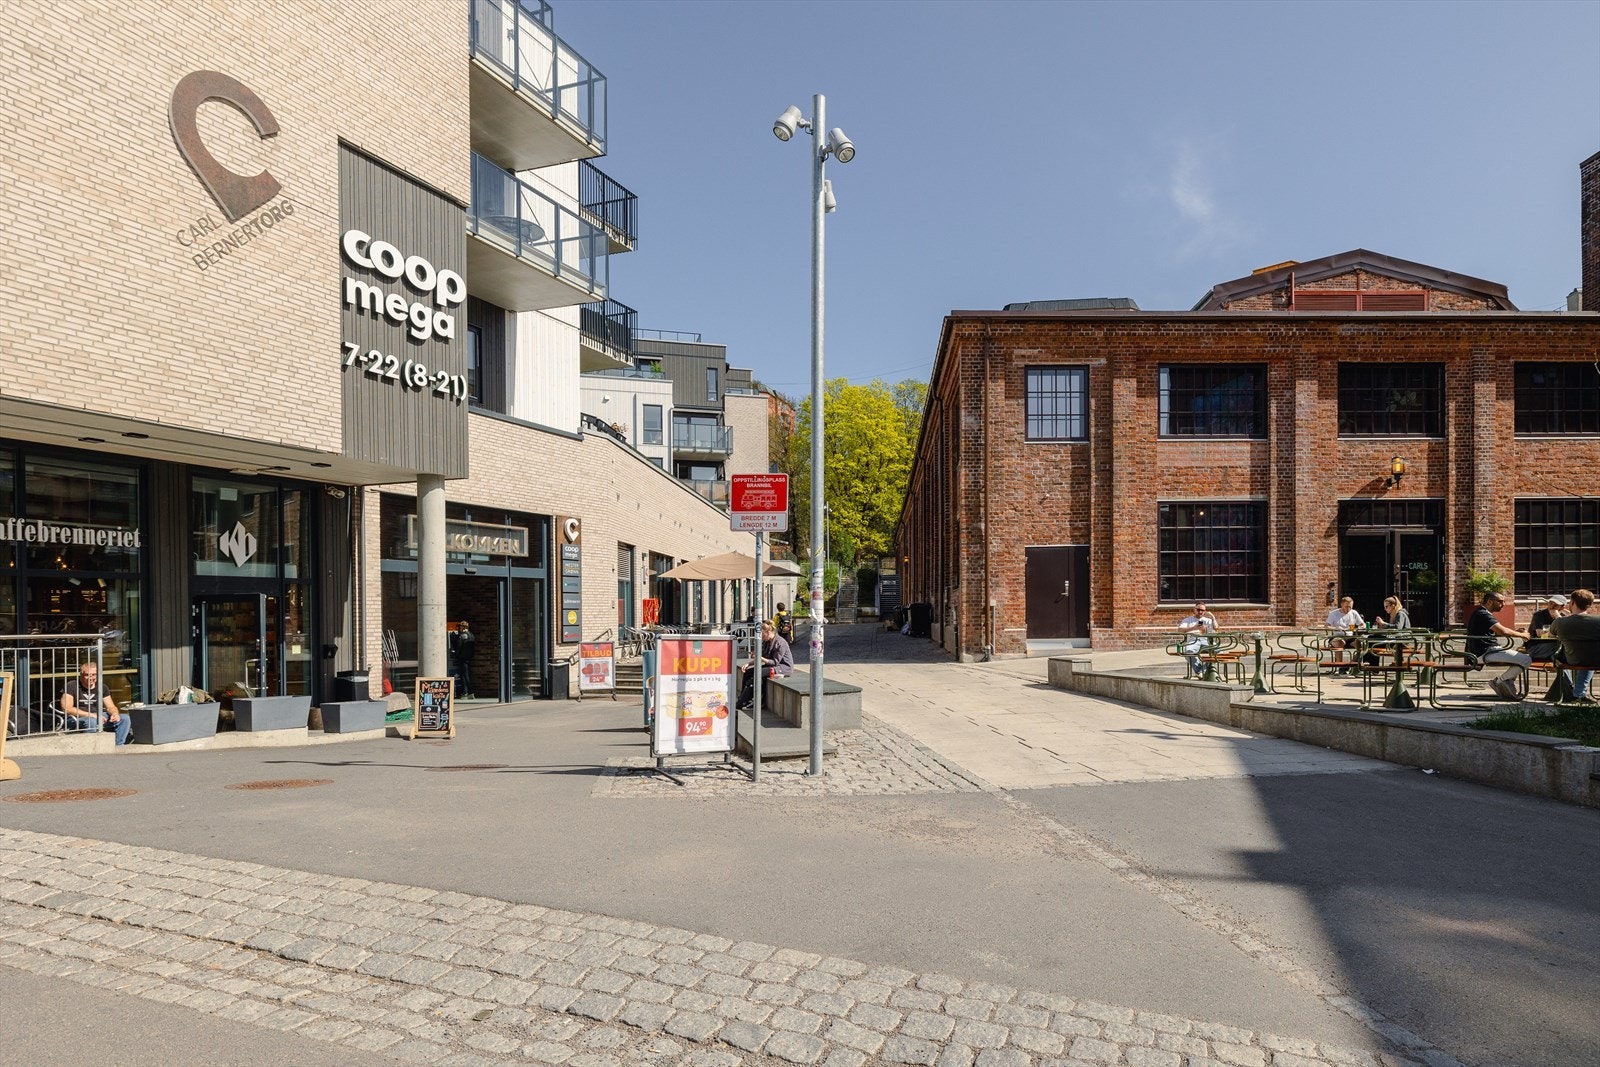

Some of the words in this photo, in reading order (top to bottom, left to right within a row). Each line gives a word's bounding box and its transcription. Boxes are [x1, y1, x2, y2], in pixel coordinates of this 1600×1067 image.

[176, 214, 223, 247] CARL
[192, 200, 294, 271] BERNERTORG
[343, 229, 467, 307] coop
[346, 276, 455, 340] mega
[343, 341, 400, 380] 7-22
[404, 358, 467, 401] (8-21)
[1408, 562, 1429, 570] CARLS
[673, 656, 722, 673] KUPP
[685, 721, 700, 734] 94
